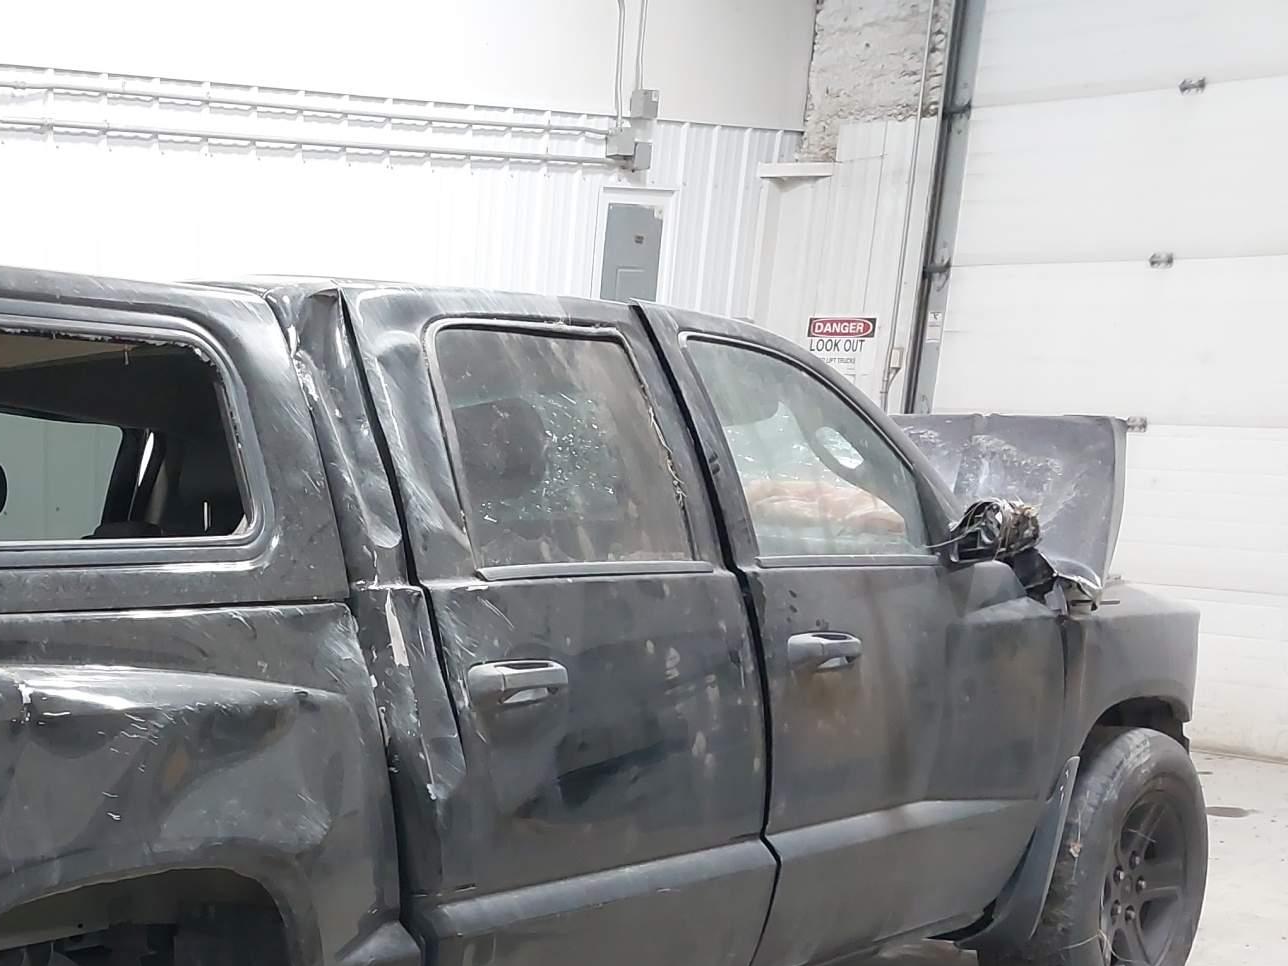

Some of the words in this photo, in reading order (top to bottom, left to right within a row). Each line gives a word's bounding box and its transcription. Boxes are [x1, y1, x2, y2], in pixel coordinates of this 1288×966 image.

[814, 322, 864, 333] DANGER
[810, 339, 841, 352] LOOK
[843, 339, 865, 352] OUT
